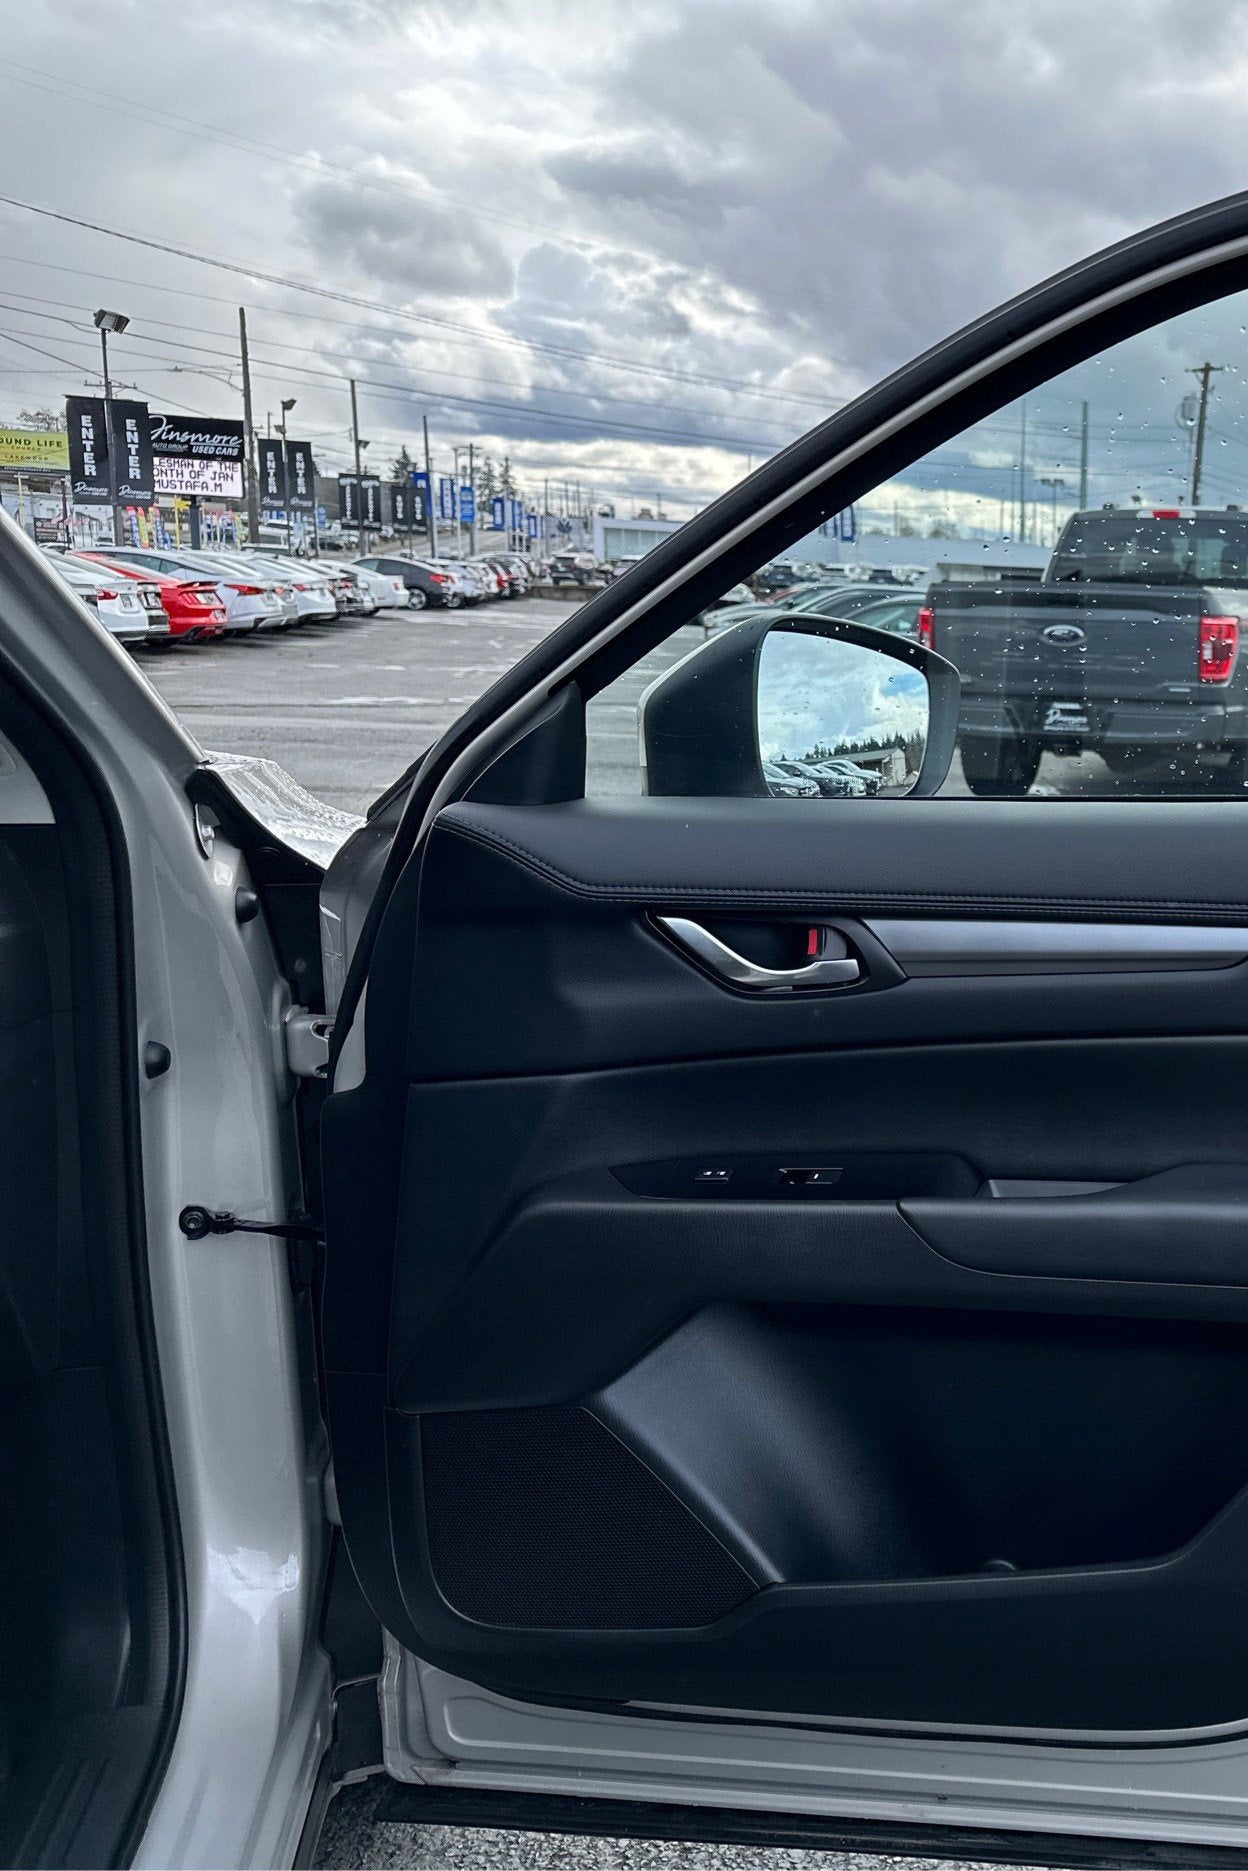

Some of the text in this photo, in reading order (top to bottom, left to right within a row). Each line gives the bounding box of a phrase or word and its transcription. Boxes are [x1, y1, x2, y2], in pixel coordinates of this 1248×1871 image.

[149, 415, 243, 446] Dinsmore
[81, 415, 97, 476] ENTER
[125, 419, 141, 479] ENTER
[192, 446, 239, 456] USED CARS
[189, 470, 205, 480] OF
[210, 471, 234, 482] JAN
[198, 460, 213, 470] OF
[219, 461, 239, 472] THE
